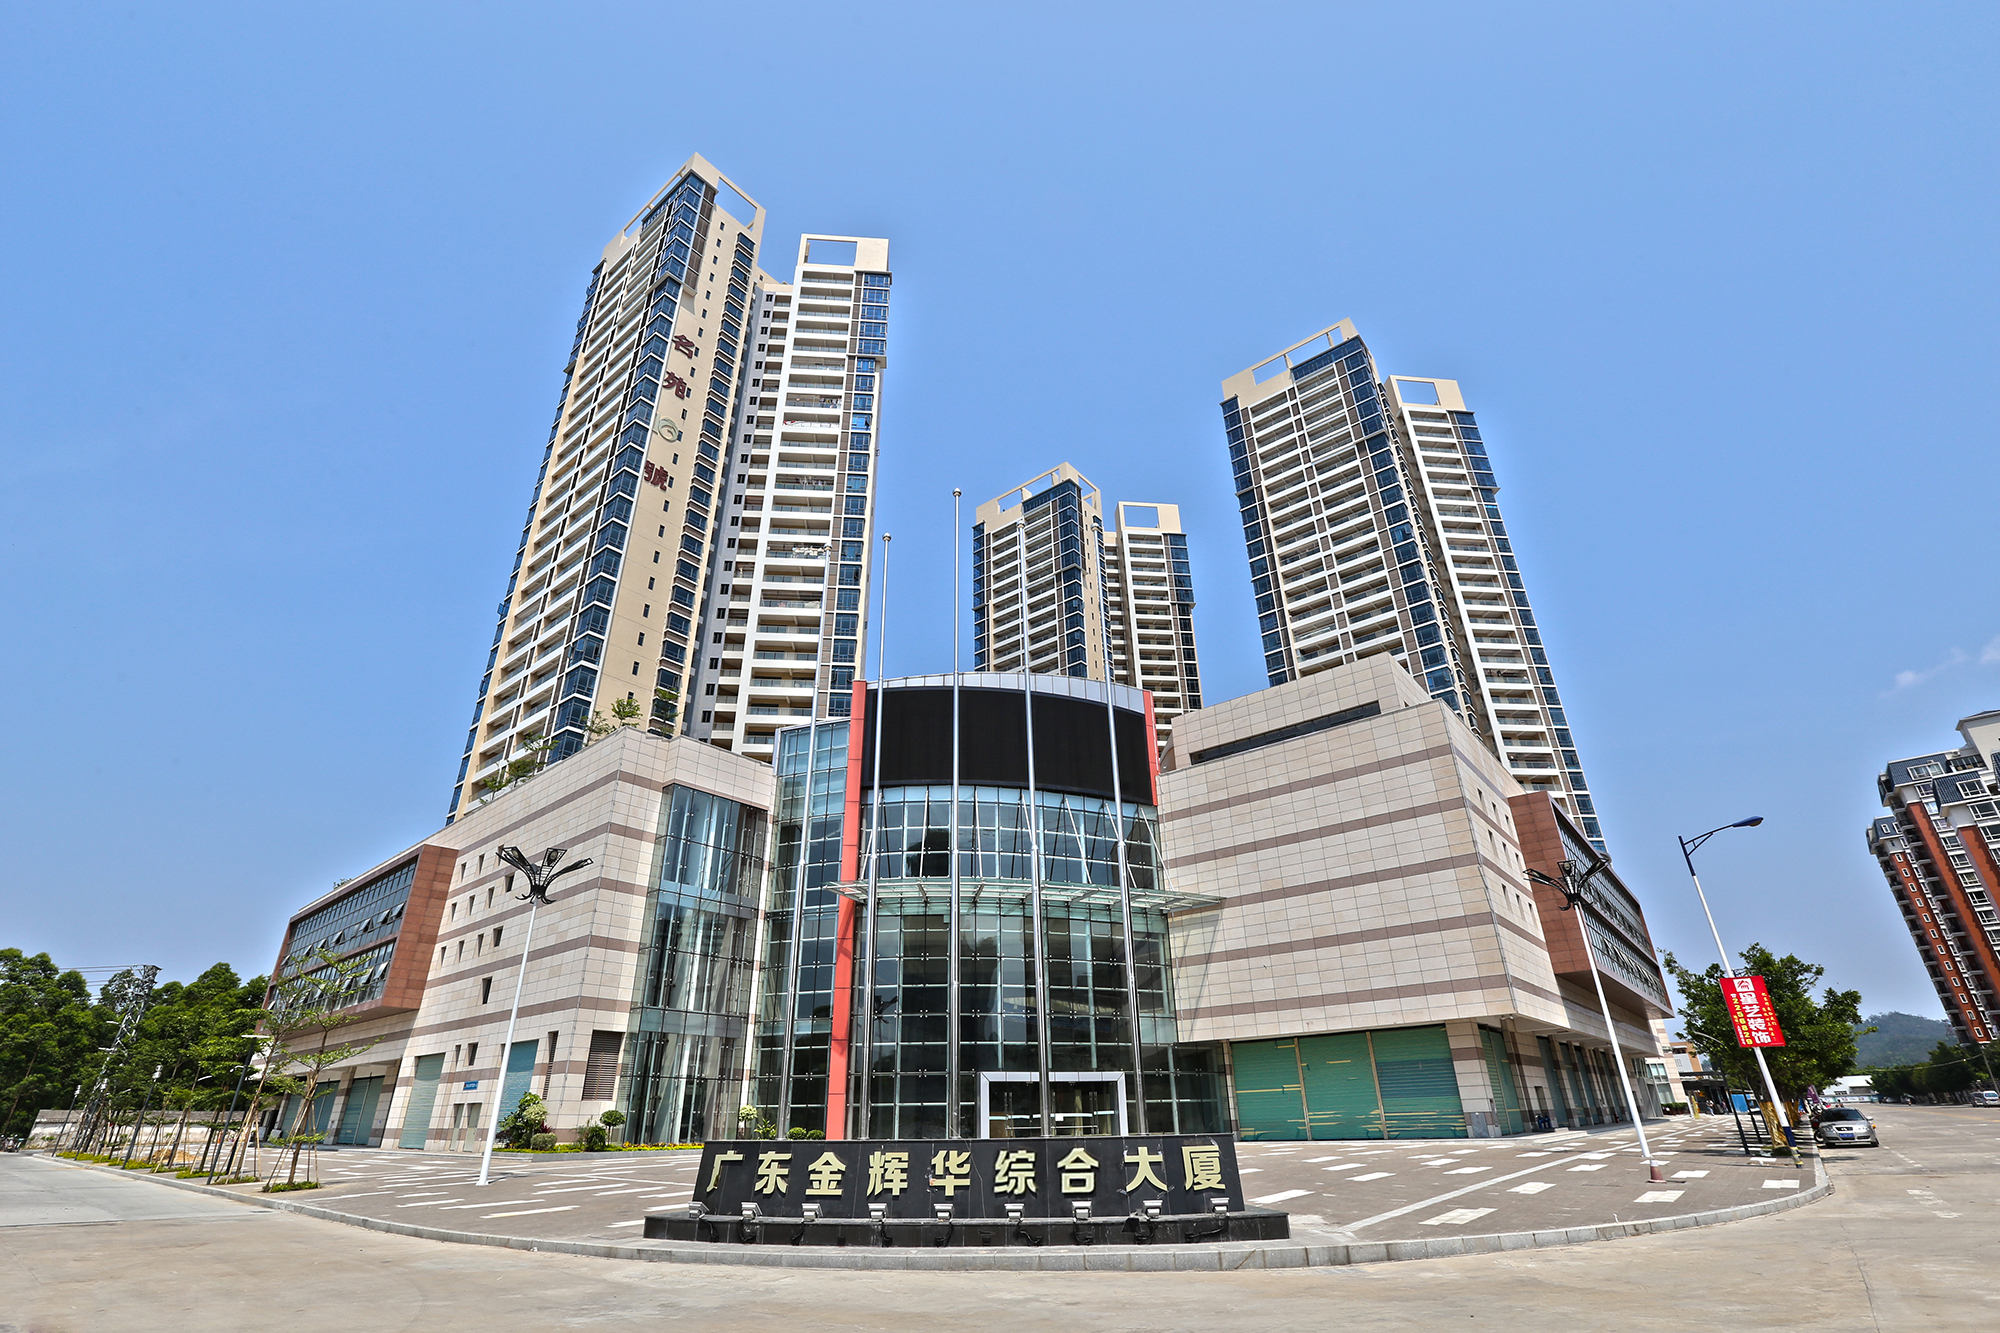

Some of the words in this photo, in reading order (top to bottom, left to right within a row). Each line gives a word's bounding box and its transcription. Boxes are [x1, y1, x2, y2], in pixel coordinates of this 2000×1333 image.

[1739, 992, 1772, 1044] 星艺装饰
[706, 1144, 1227, 1196] 广东金辉华综合大厦
